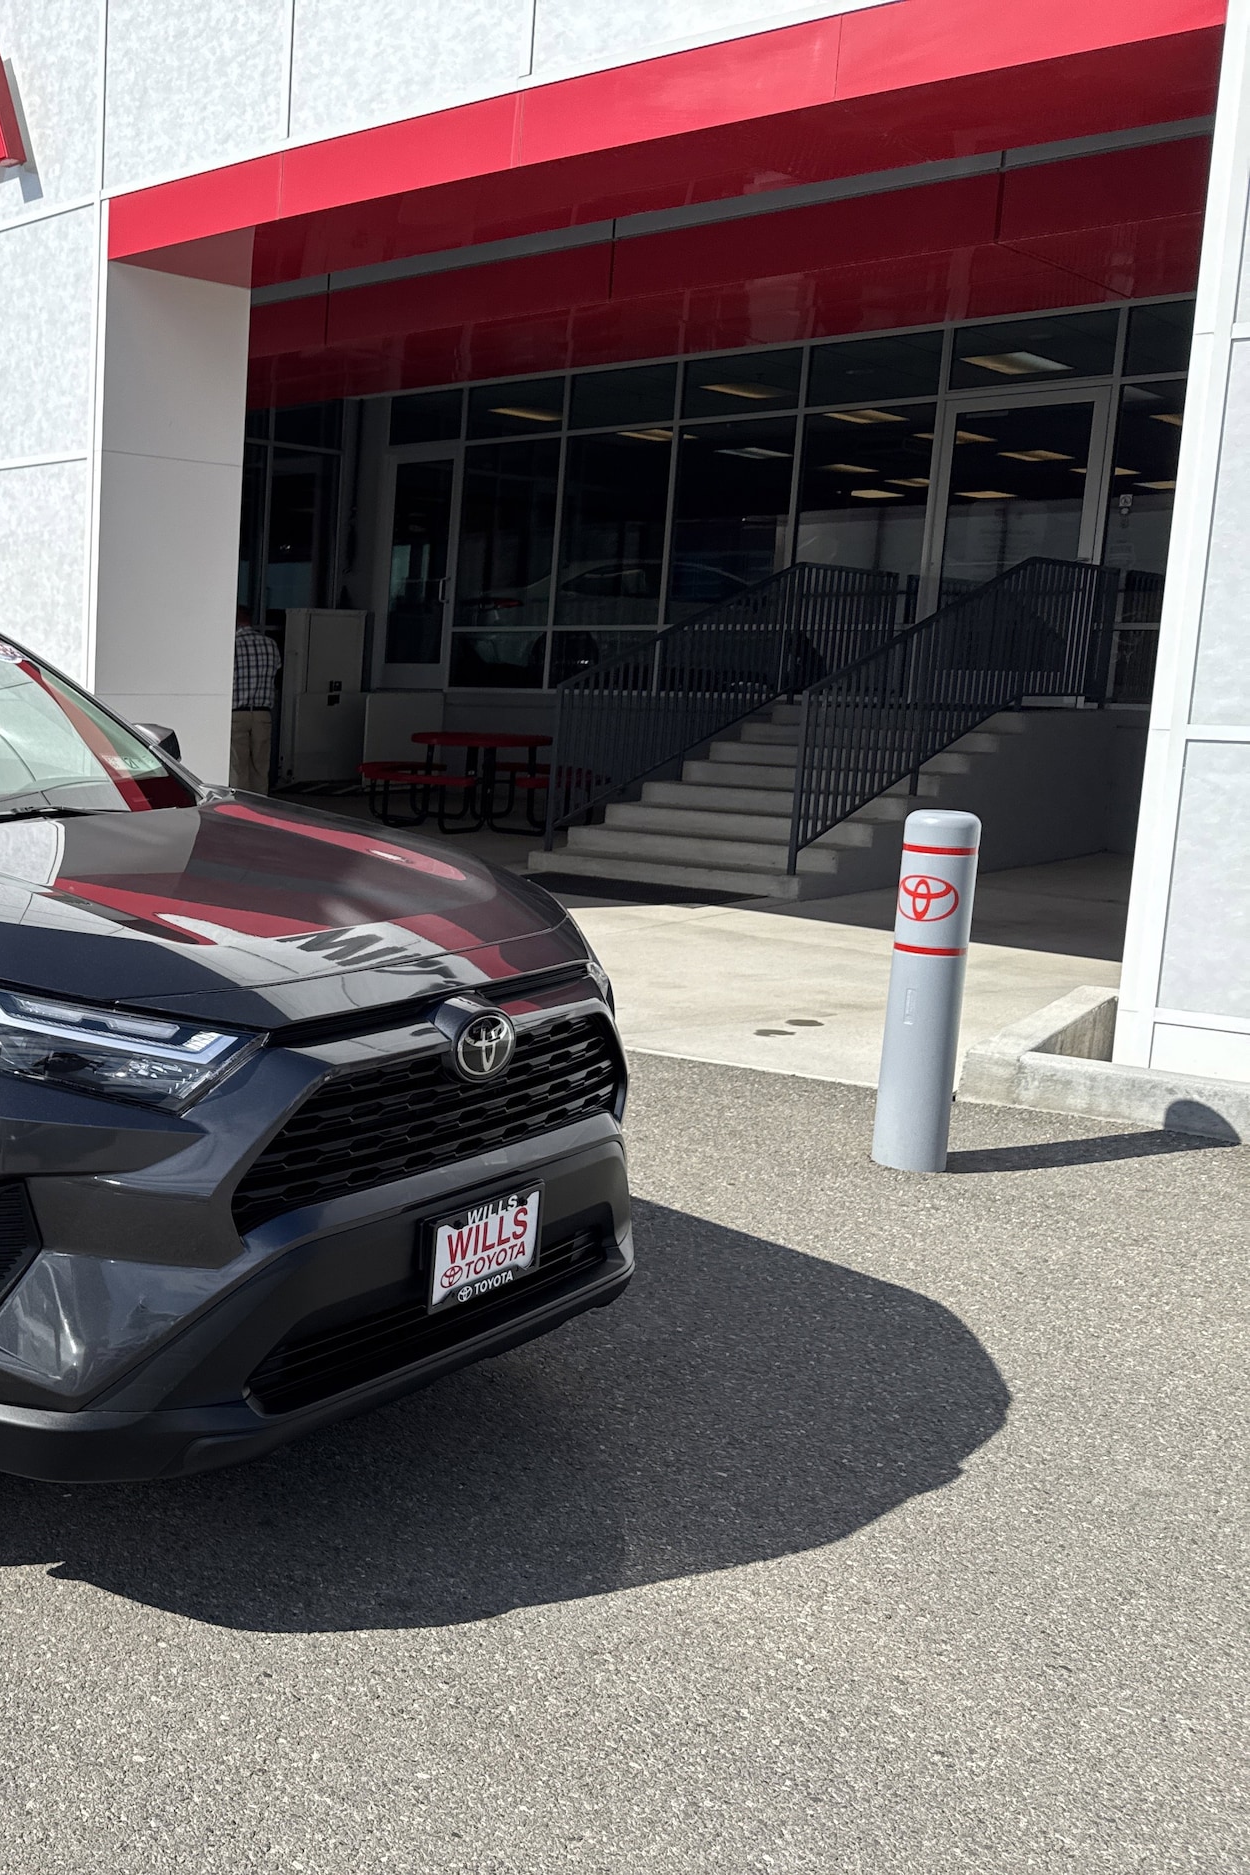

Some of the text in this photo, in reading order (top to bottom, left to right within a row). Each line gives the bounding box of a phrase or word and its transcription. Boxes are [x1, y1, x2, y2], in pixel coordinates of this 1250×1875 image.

[467, 1194, 518, 1226] WILLS
[447, 1207, 528, 1264] WILLS
[464, 1241, 526, 1279] TOYOTA
[474, 1269, 514, 1295] TOYOTA
